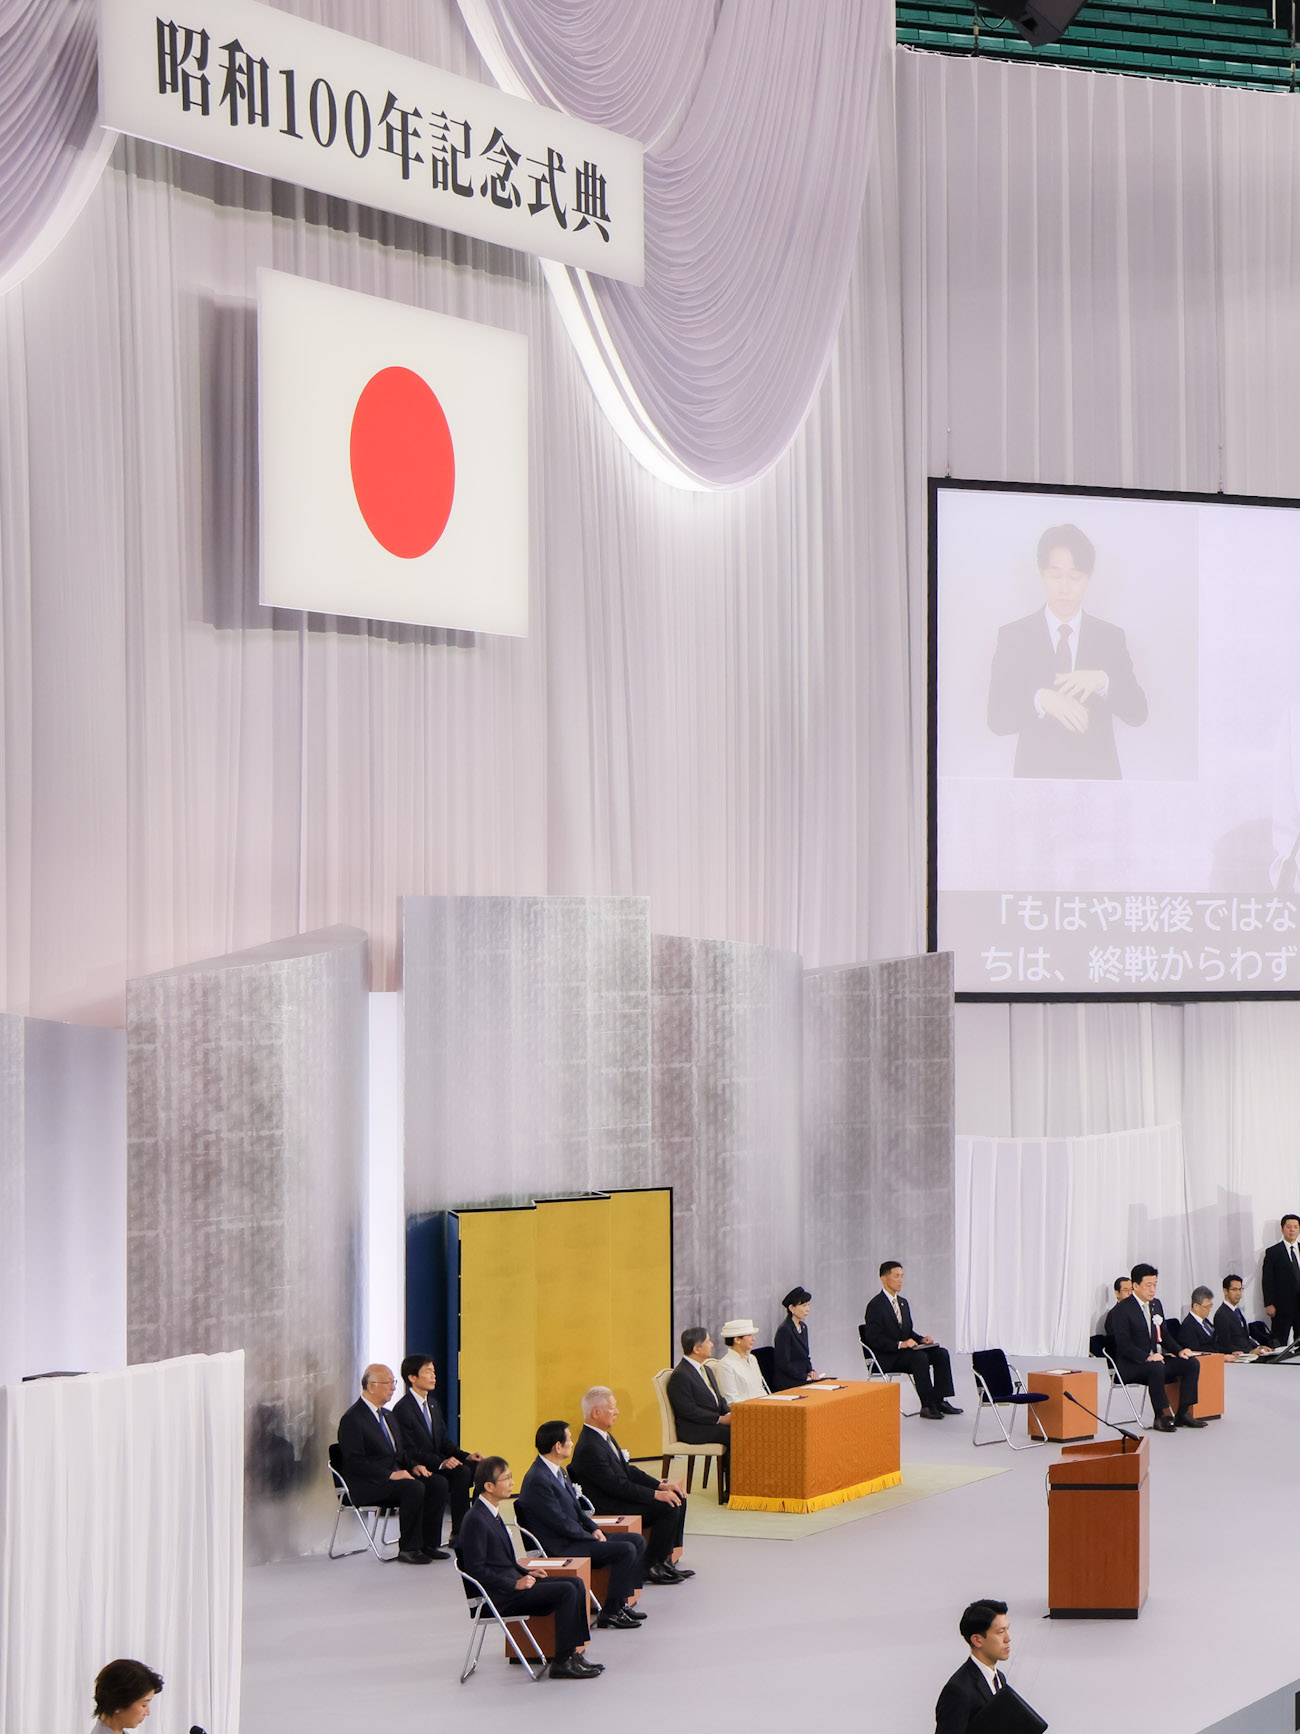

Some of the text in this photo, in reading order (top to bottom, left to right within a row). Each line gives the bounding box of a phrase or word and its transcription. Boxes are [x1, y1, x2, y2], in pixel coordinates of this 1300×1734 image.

[155, 15, 612, 243] 昭和100年記念式典
